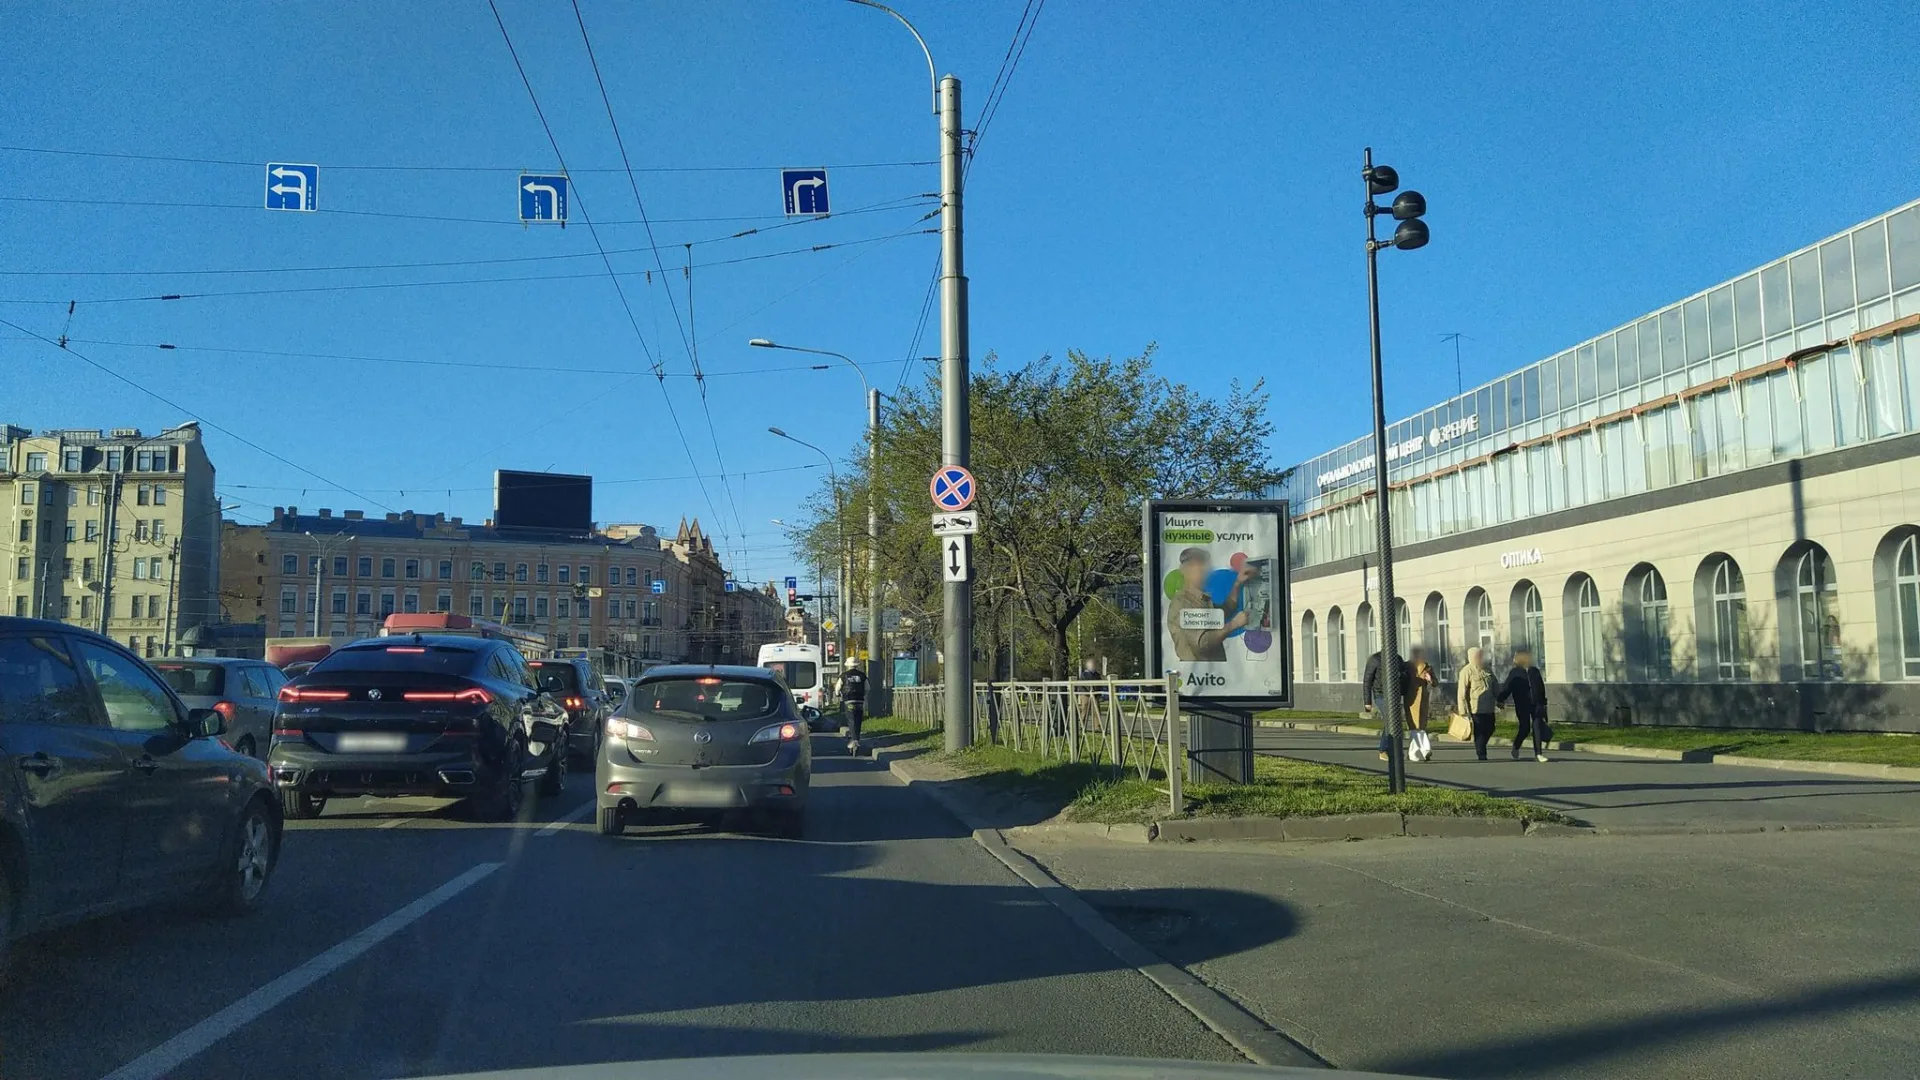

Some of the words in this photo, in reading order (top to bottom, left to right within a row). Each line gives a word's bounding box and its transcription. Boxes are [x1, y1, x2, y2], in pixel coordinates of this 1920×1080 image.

[1439, 413, 1478, 444] ЗРЕНИЕ
[1165, 516, 1204, 528] Ищите
[1165, 532, 1211, 543] нужные
[1216, 532, 1254, 542] услуги
[1500, 548, 1544, 569] ОПТИКА
[1186, 672, 1226, 686] Avito
